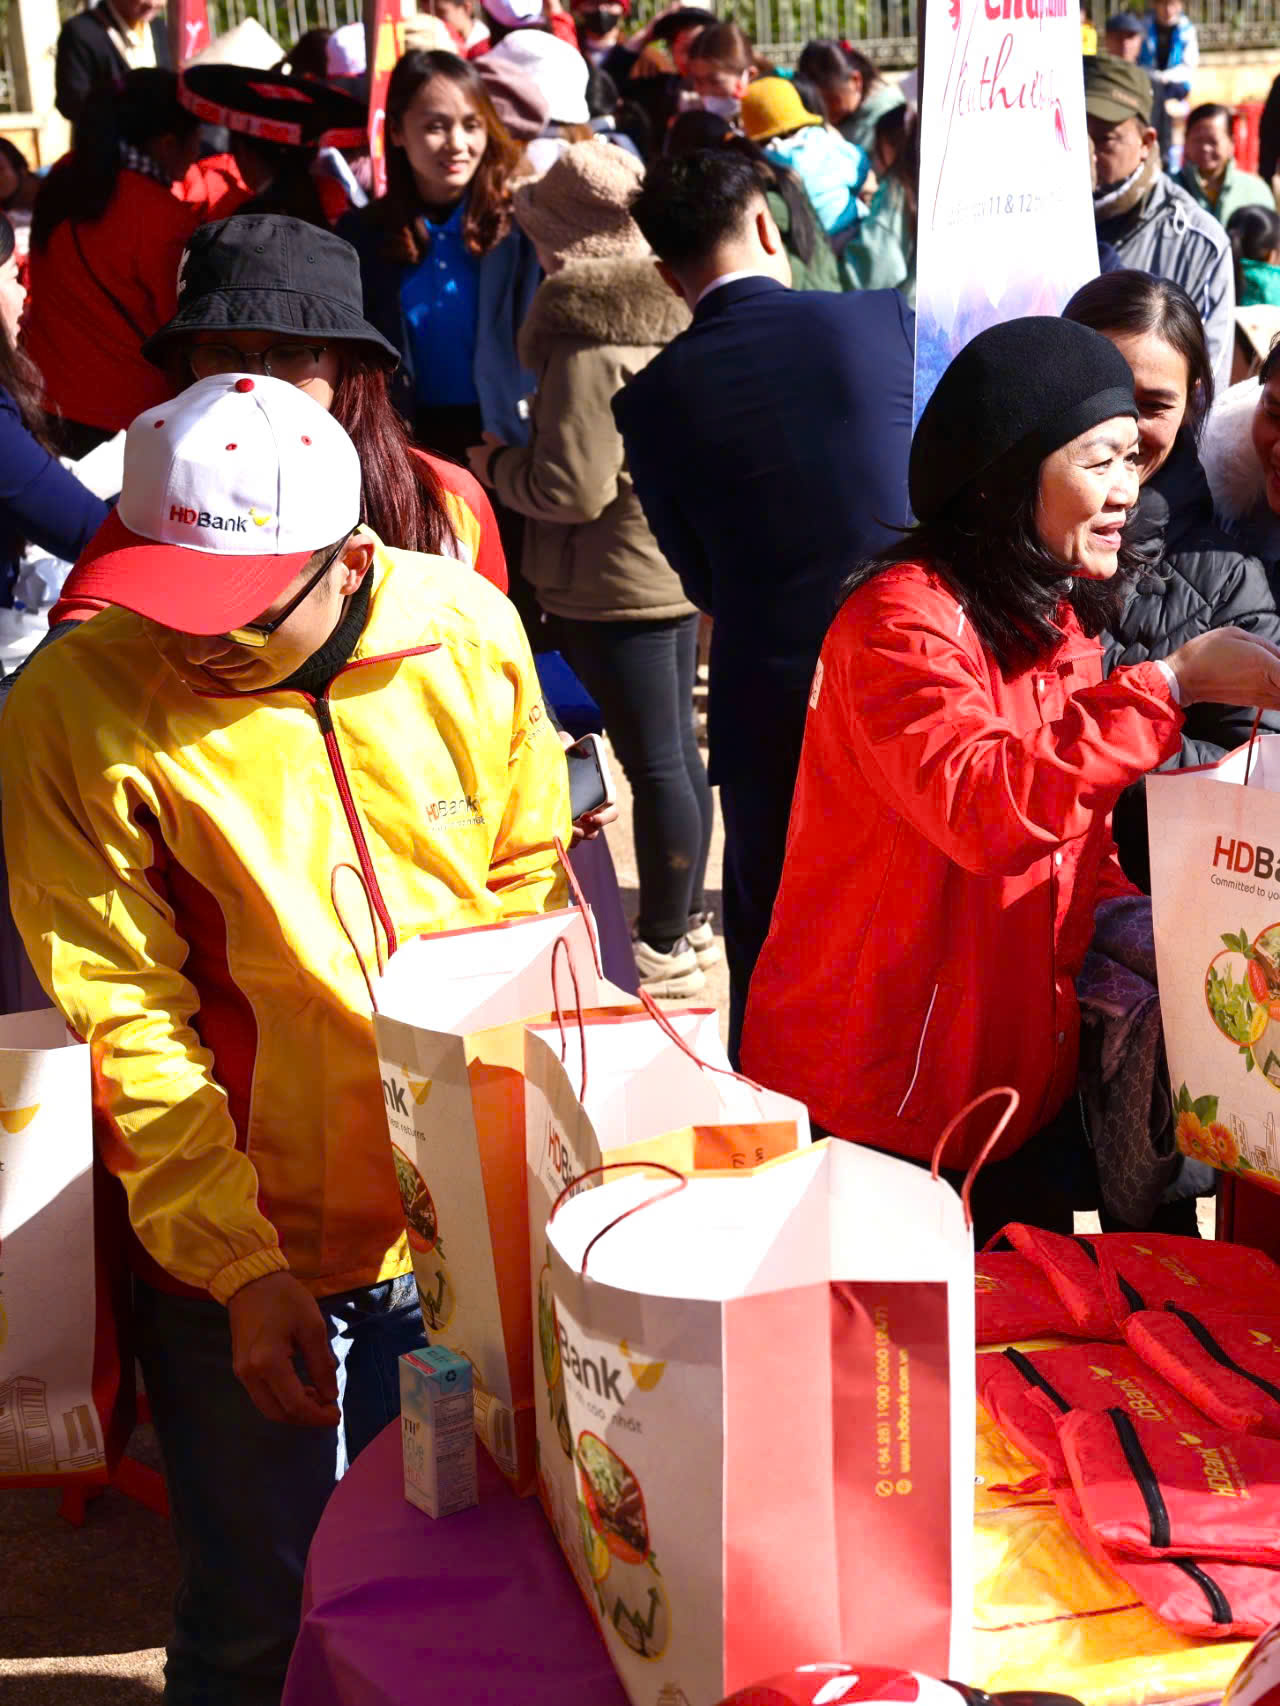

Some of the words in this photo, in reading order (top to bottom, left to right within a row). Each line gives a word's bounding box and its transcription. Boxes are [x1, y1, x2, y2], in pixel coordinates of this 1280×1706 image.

[1004, 193, 1014, 214] &
[169, 504, 248, 533] HDBank
[1210, 873, 1256, 895] Committed
[1256, 885, 1266, 898] to
[559, 1320, 625, 1406] Bank
[876, 1347, 890, 1384] 6060
[876, 1384, 890, 1418] 1900
[1111, 1378, 1165, 1422] DBank
